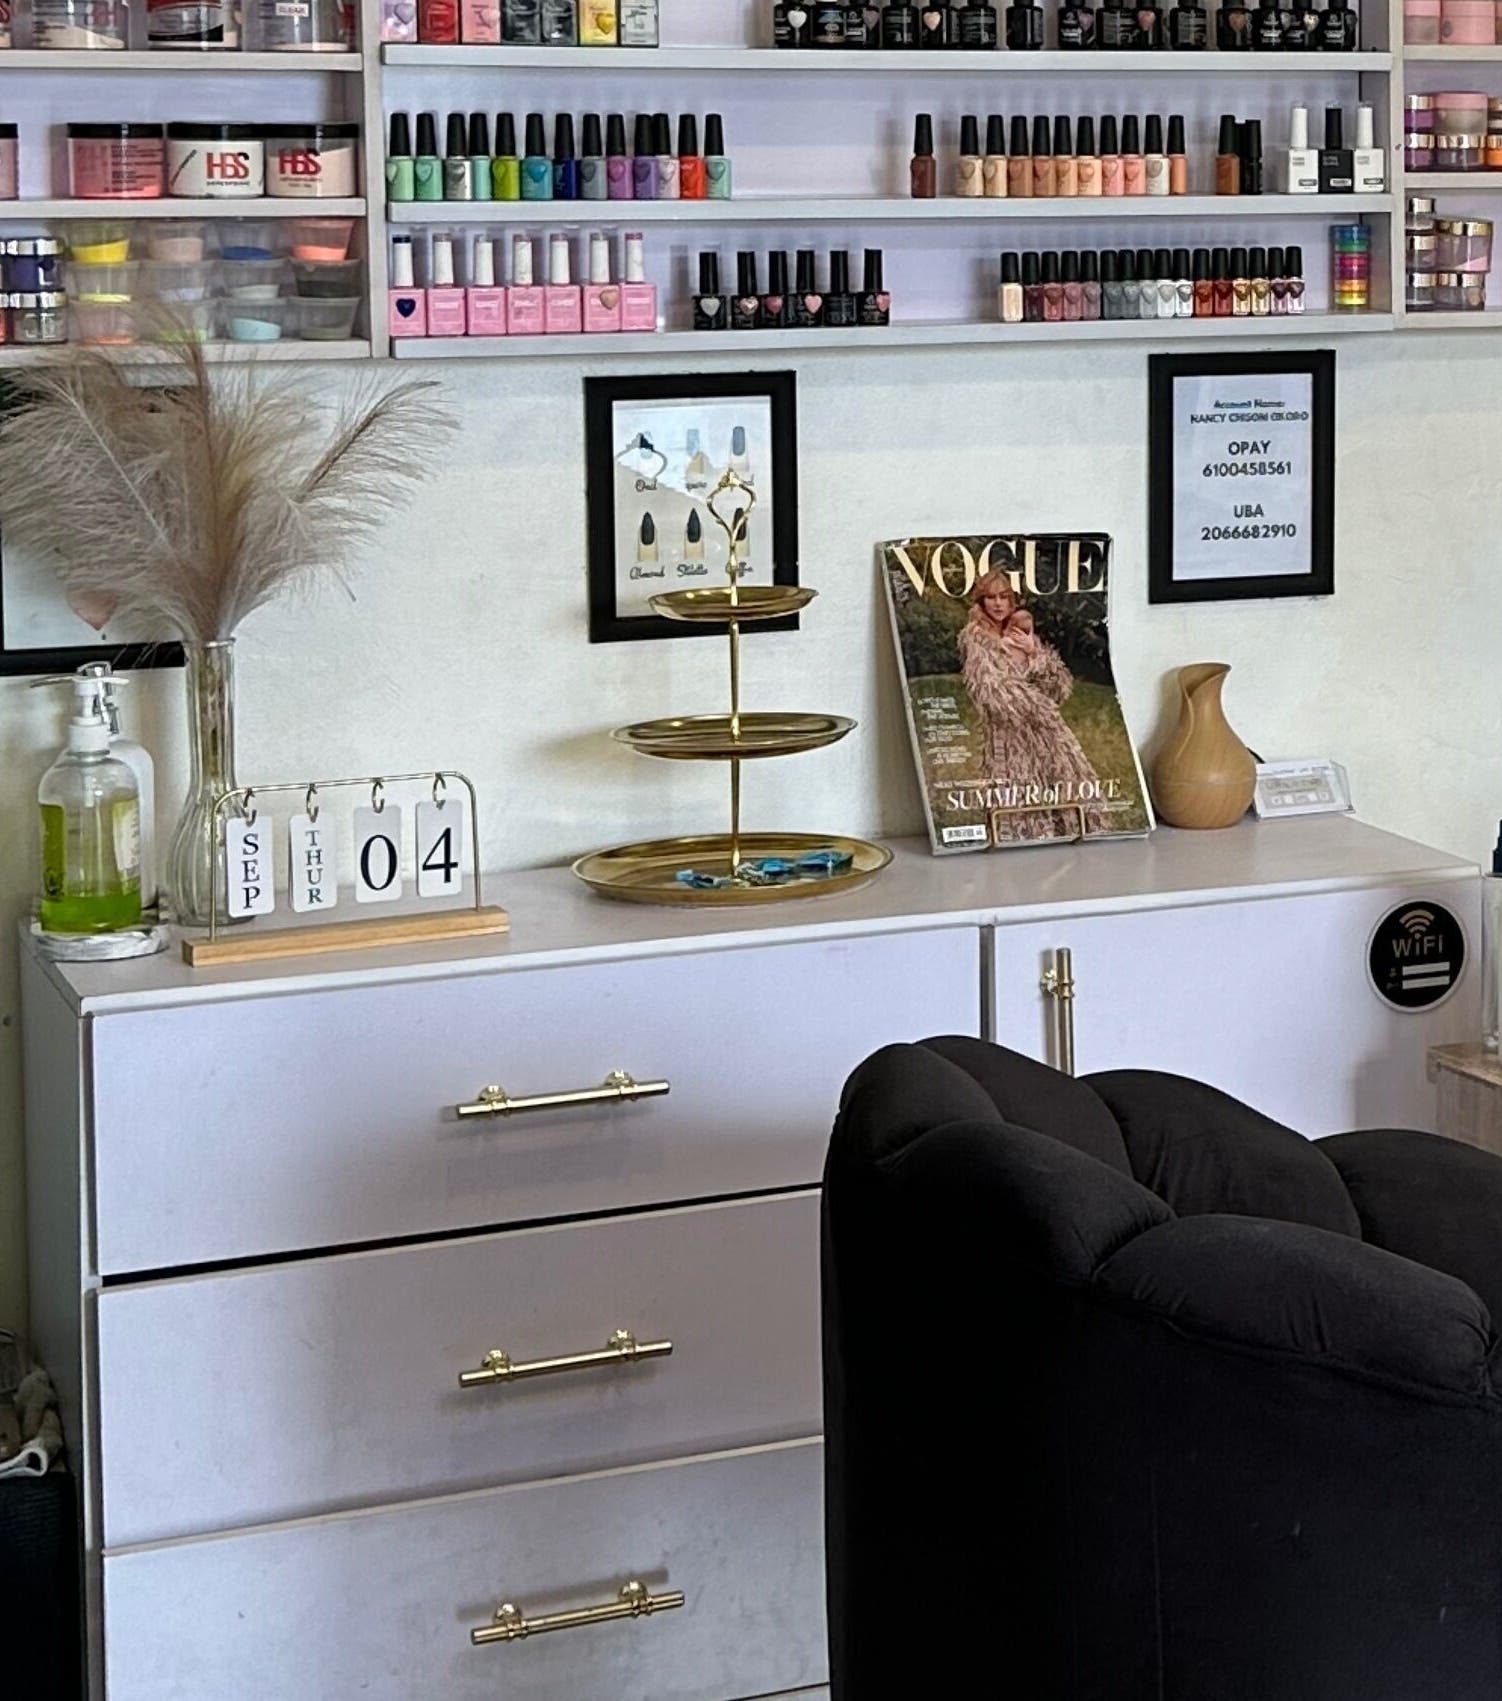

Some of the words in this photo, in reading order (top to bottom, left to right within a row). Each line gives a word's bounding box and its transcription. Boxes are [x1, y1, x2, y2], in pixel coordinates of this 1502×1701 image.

[1228, 440, 1271, 455] OPAY
[1202, 461, 1291, 477] 6100458561
[1233, 504, 1264, 518] UBA
[1201, 524, 1296, 541] 2066682910
[890, 539, 1104, 598] VOGUE
[947, 784, 1040, 811] SUMMER
[1043, 781, 1063, 805] of
[1066, 779, 1121, 802] LOVE
[242, 833, 261, 909] SEP
[305, 830, 323, 904] THUR
